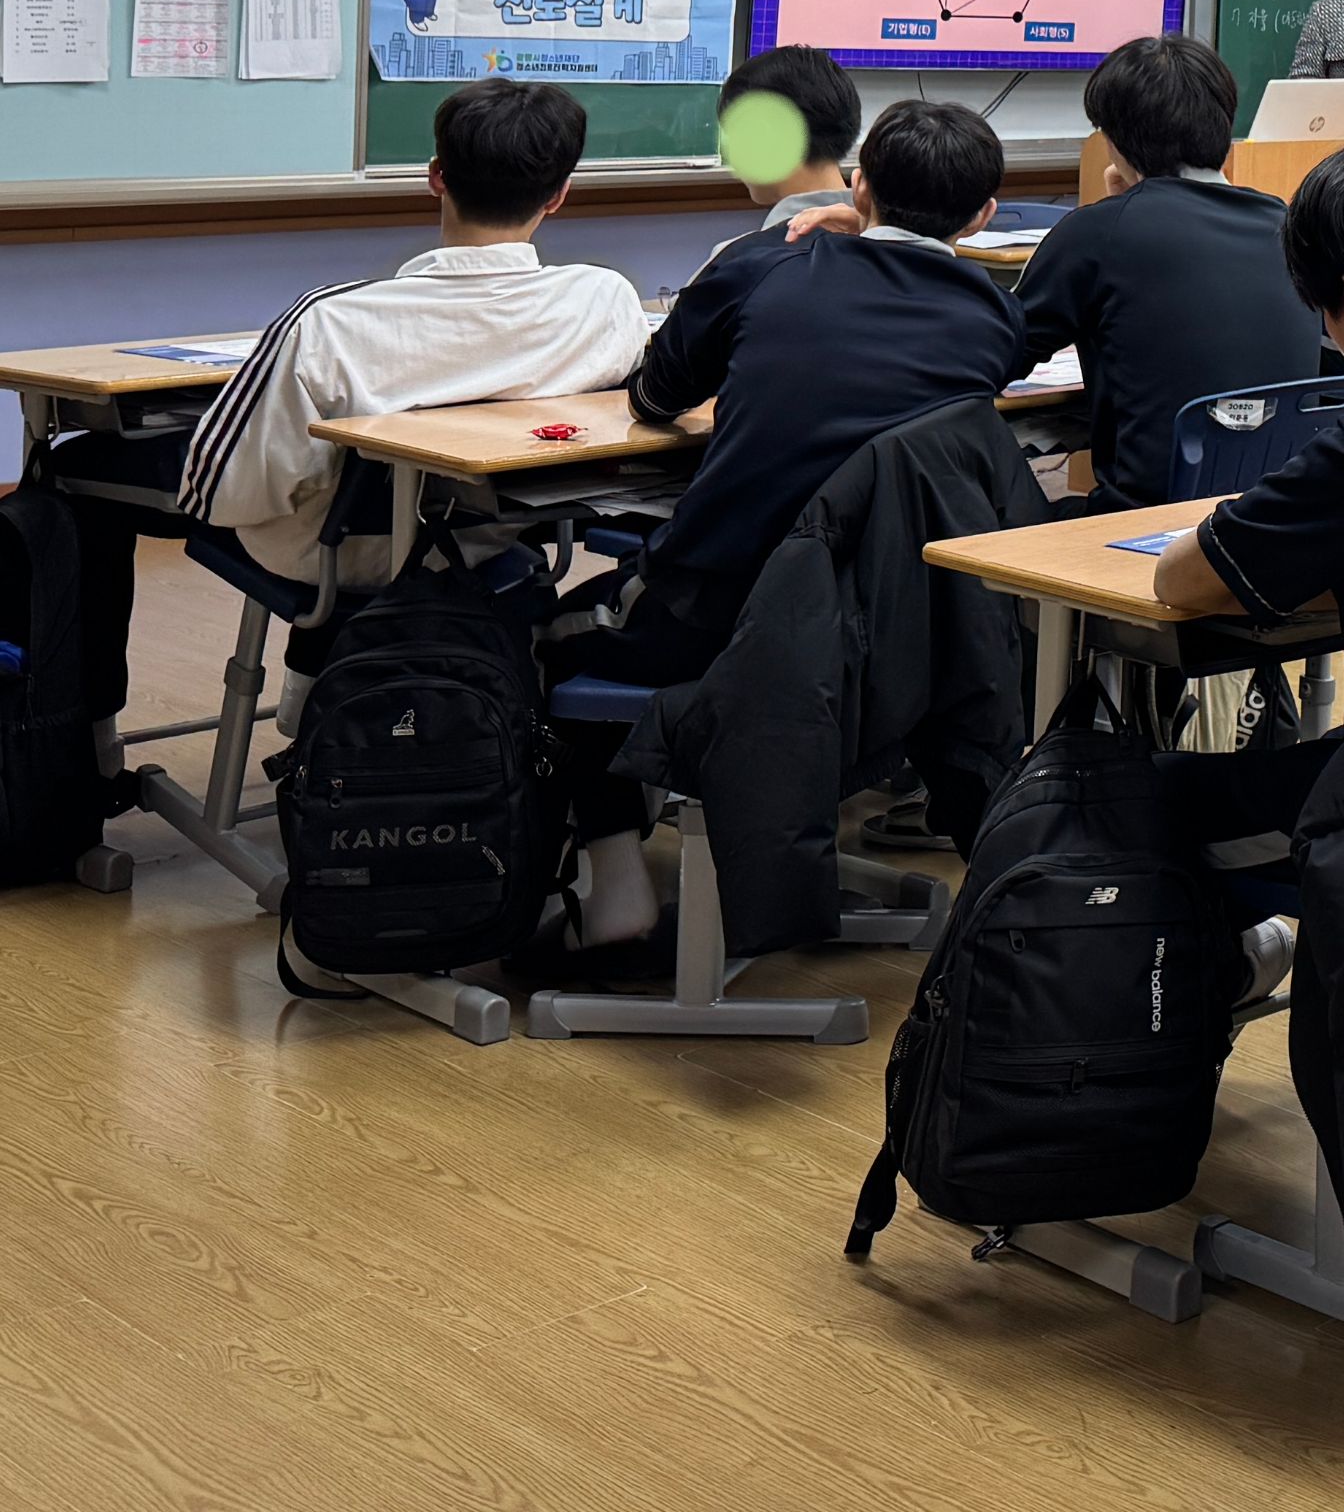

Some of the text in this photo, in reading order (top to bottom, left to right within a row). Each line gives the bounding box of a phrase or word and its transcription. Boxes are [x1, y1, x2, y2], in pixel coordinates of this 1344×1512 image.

[330, 822, 477, 850] KANGOL
[1151, 938, 1165, 1032] new balance
